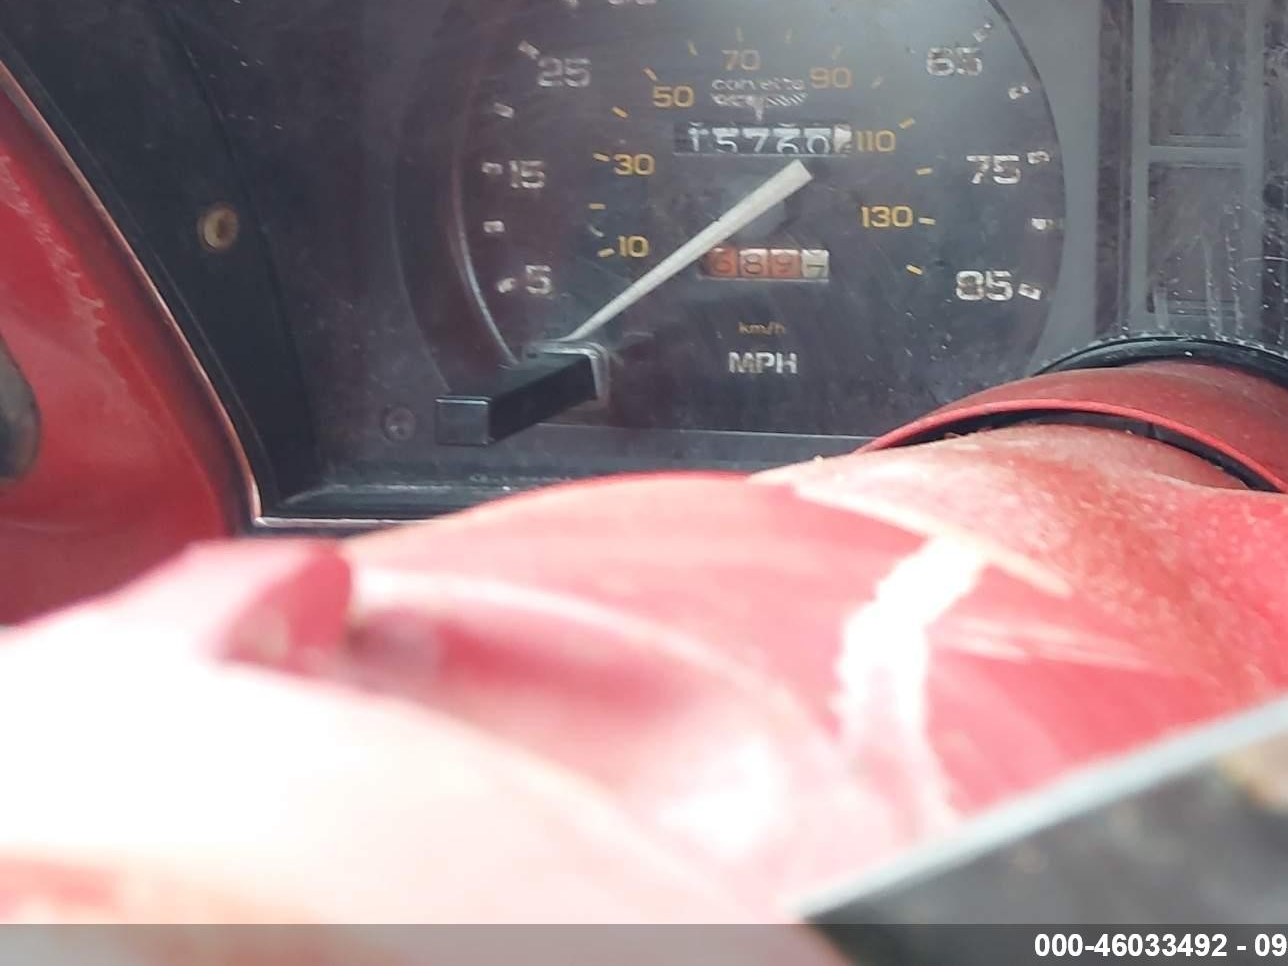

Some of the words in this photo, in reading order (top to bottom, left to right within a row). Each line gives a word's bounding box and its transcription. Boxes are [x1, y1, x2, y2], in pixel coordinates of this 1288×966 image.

[721, 50, 761, 71] 70
[926, 47, 983, 76] 65
[537, 57, 591, 87] 25
[810, 67, 852, 89] 90
[652, 86, 695, 108] 50
[856, 130, 896, 152] 110
[509, 160, 546, 189] 15
[613, 154, 655, 176] 30
[966, 155, 1021, 184] 75
[861, 206, 914, 228] 130
[617, 236, 650, 258] 10
[525, 264, 552, 296] 5
[955, 270, 1014, 301] 85
[728, 351, 798, 374] MPH
